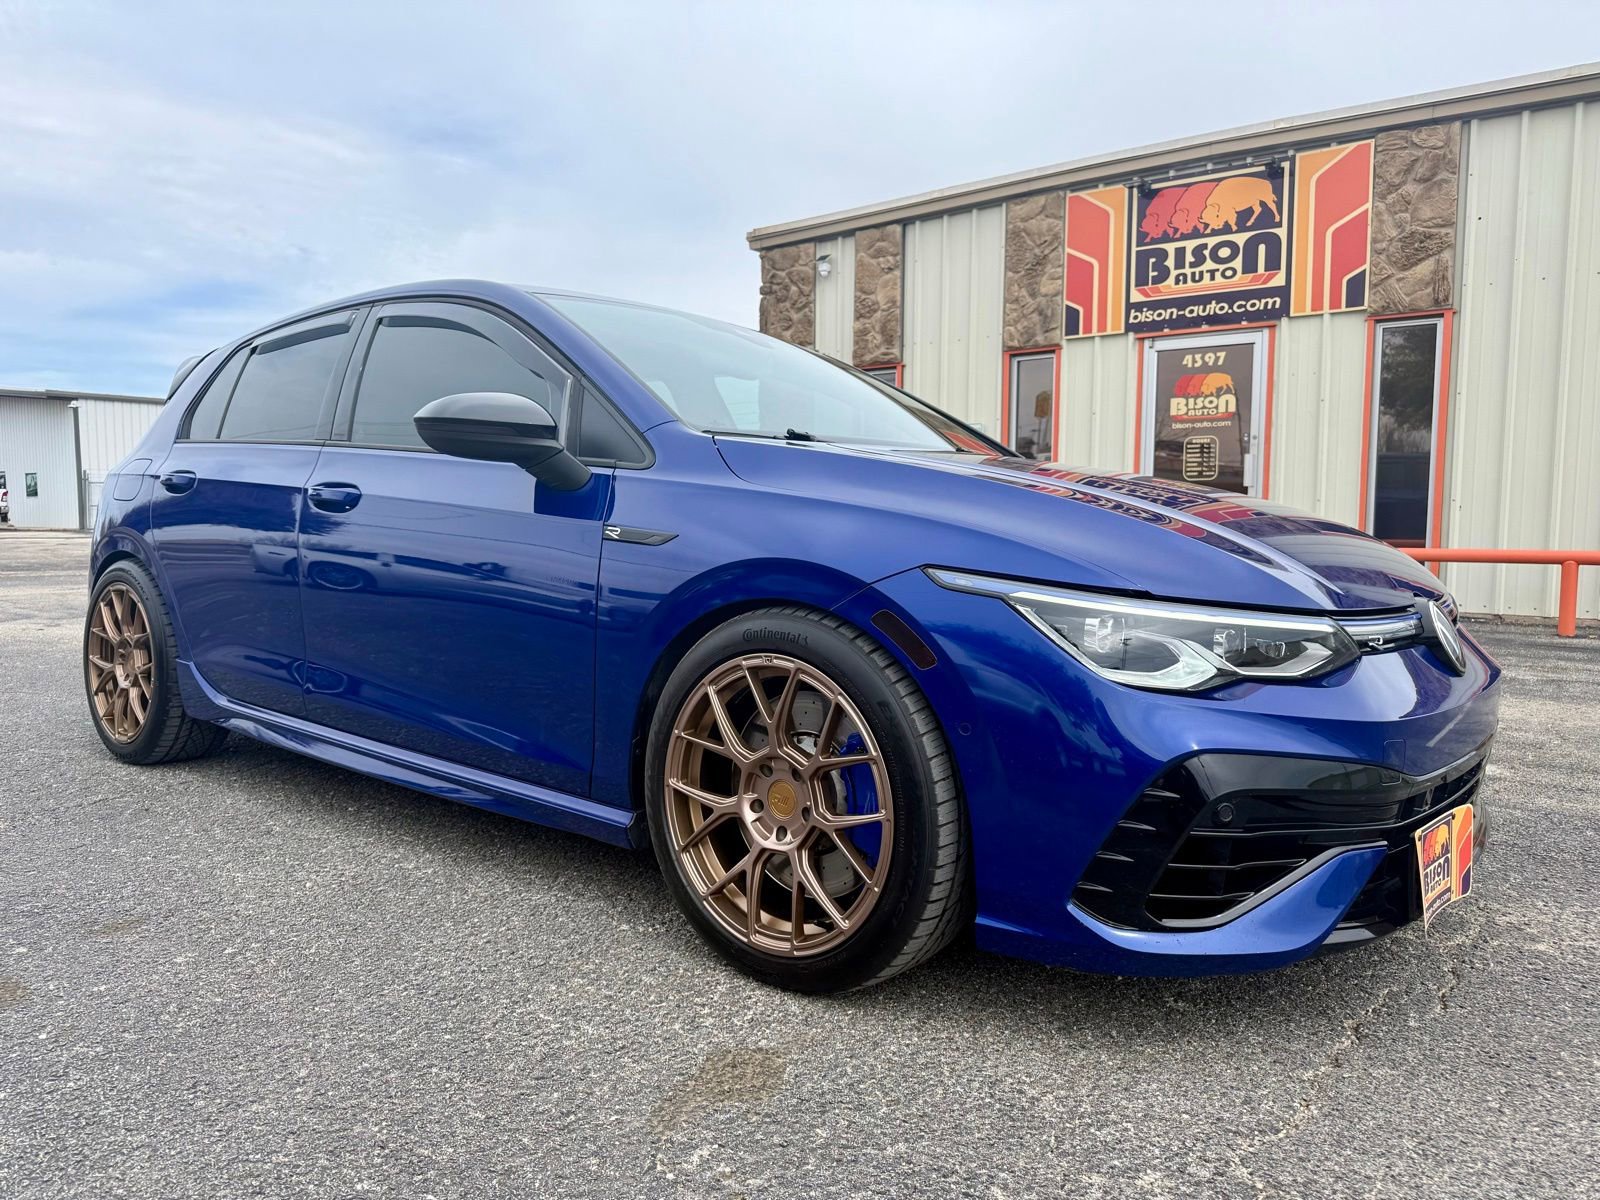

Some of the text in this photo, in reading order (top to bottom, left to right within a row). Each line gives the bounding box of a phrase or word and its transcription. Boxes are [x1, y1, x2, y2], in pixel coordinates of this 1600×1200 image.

[1134, 231, 1282, 289] BISON
[1173, 266, 1238, 286] AUTO
[1128, 296, 1281, 324] bison-auto.com
[1182, 351, 1226, 368] 4397
[1188, 408, 1217, 416] AUTO
[1171, 420, 1232, 430] bison-auto.com
[604, 526, 621, 539] R
[742, 627, 802, 644] Continental
